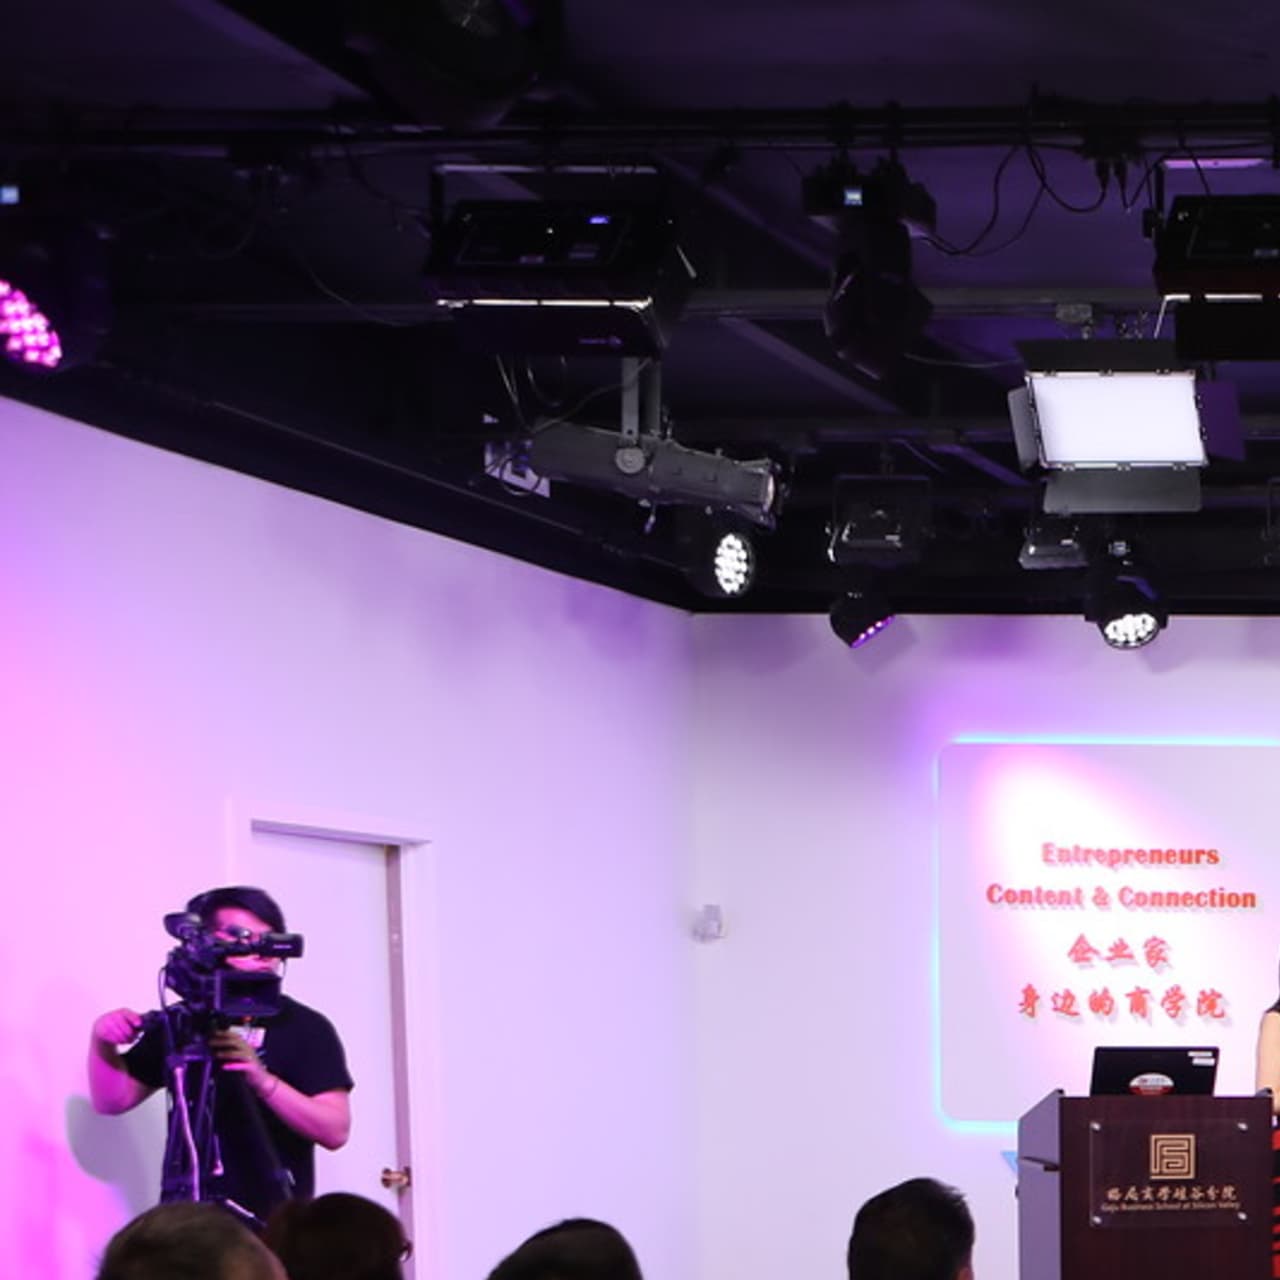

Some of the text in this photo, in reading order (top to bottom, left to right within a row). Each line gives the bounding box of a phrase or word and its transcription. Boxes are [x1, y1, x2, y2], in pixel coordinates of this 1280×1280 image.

[1041, 843, 1221, 868] Entrepreneurs
[986, 884, 1257, 909] Content & Connection
[1067, 933, 1169, 968] 企业家
[1018, 983, 1226, 1019] 身边的商学院
